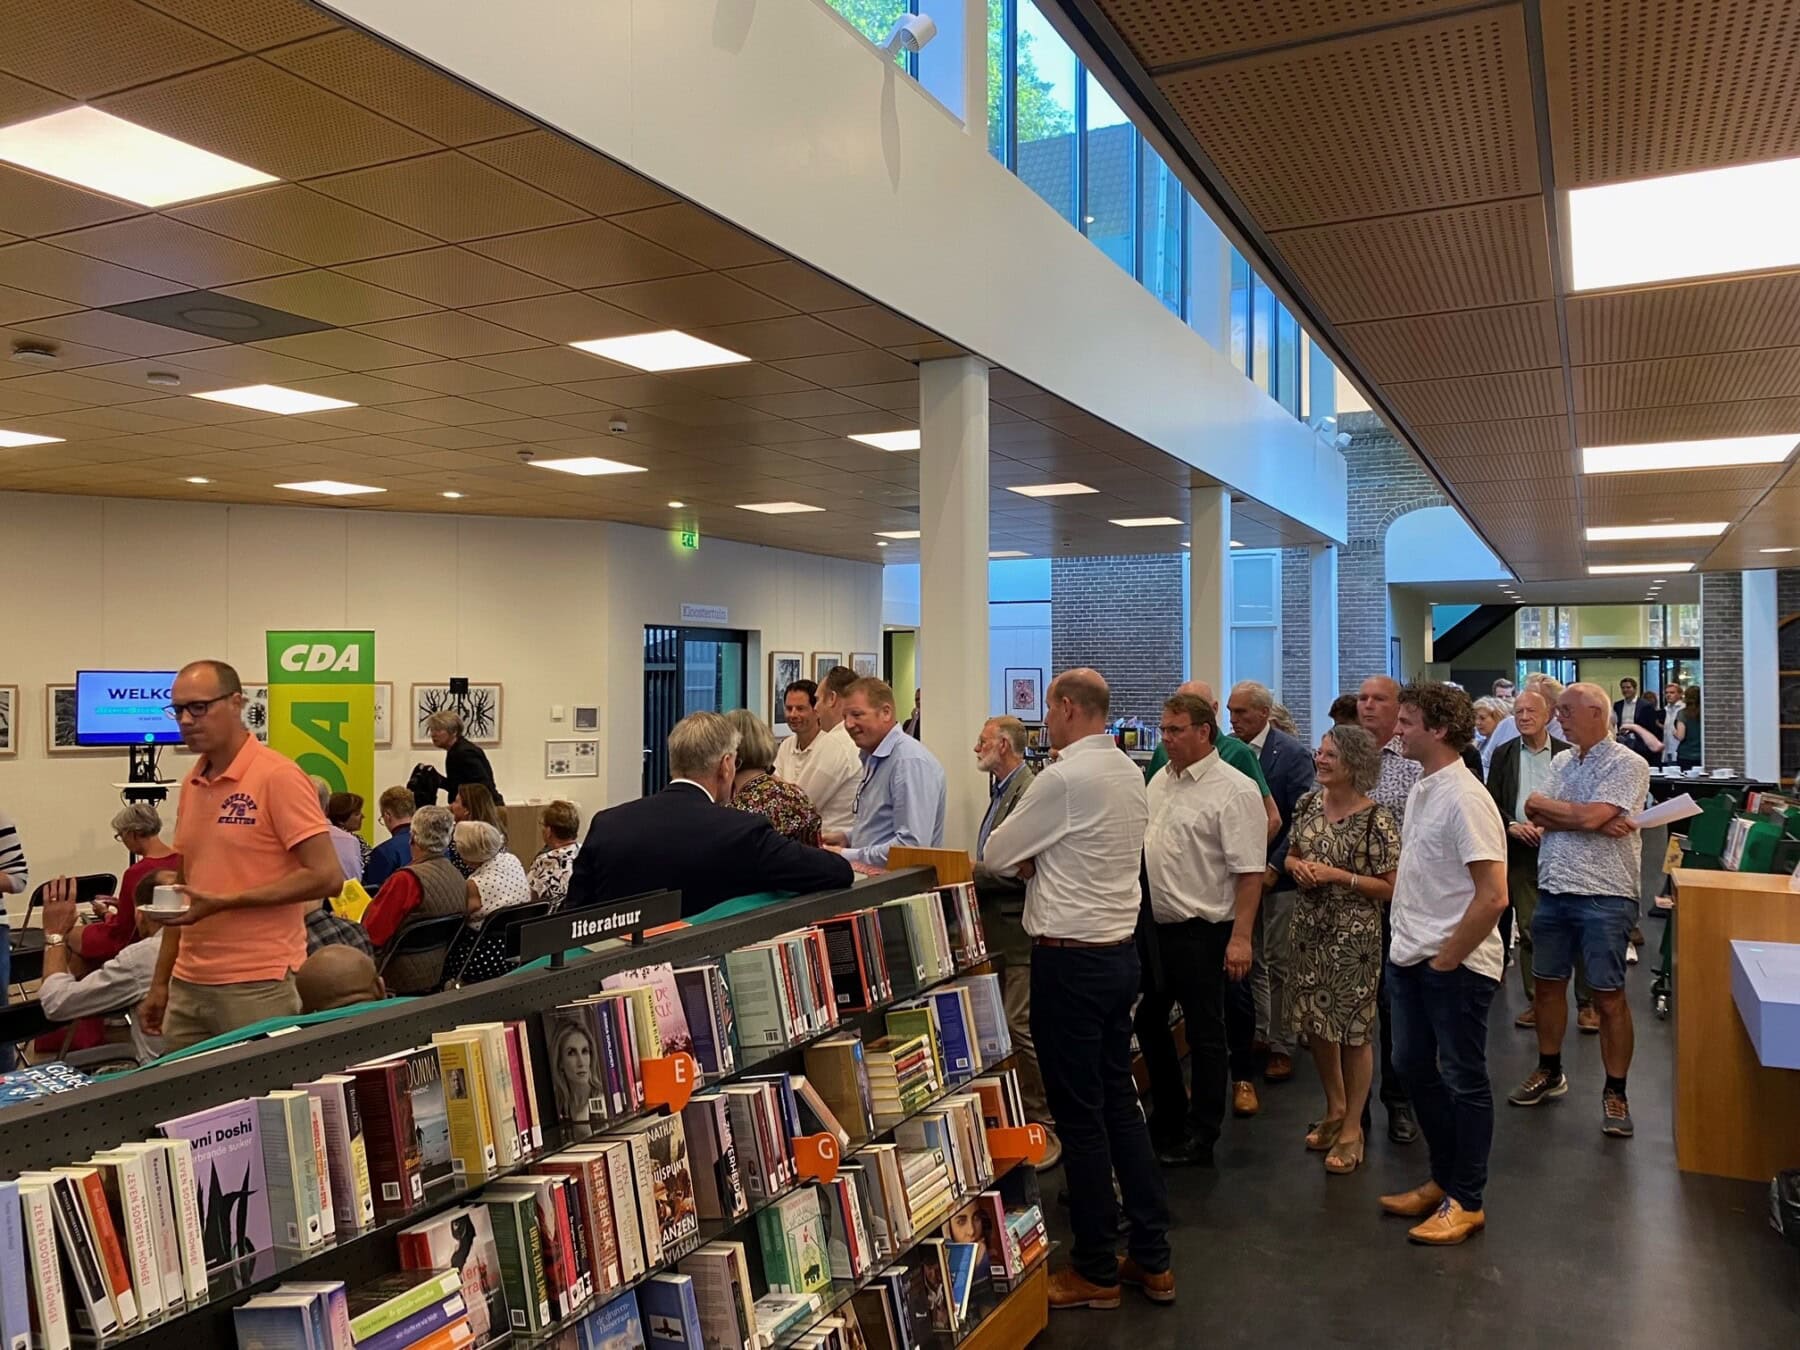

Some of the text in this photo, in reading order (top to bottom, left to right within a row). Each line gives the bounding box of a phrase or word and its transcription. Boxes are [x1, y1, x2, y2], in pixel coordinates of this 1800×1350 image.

[280, 644, 359, 671] CDA
[571, 910, 641, 939] literatuur
[674, 1059, 686, 1083] E
[190, 1118, 252, 1150] vni Doshi
[817, 1139, 833, 1159] G
[1028, 1129, 1042, 1145] H
[177, 1156, 187, 1185] ZEVEN
[612, 1153, 625, 1199] FOLLETT
[126, 1172, 138, 1201] ZEVEN
[591, 1161, 605, 1198] HIER
[598, 1199, 610, 1227] BEN
[33, 1203, 46, 1236] ZEVEN
[181, 1188, 193, 1229] SOORTEN
[130, 1204, 144, 1248] SOORTEN
[662, 1216, 696, 1246] ANZEN
[38, 1238, 52, 1284] SOORTEN
